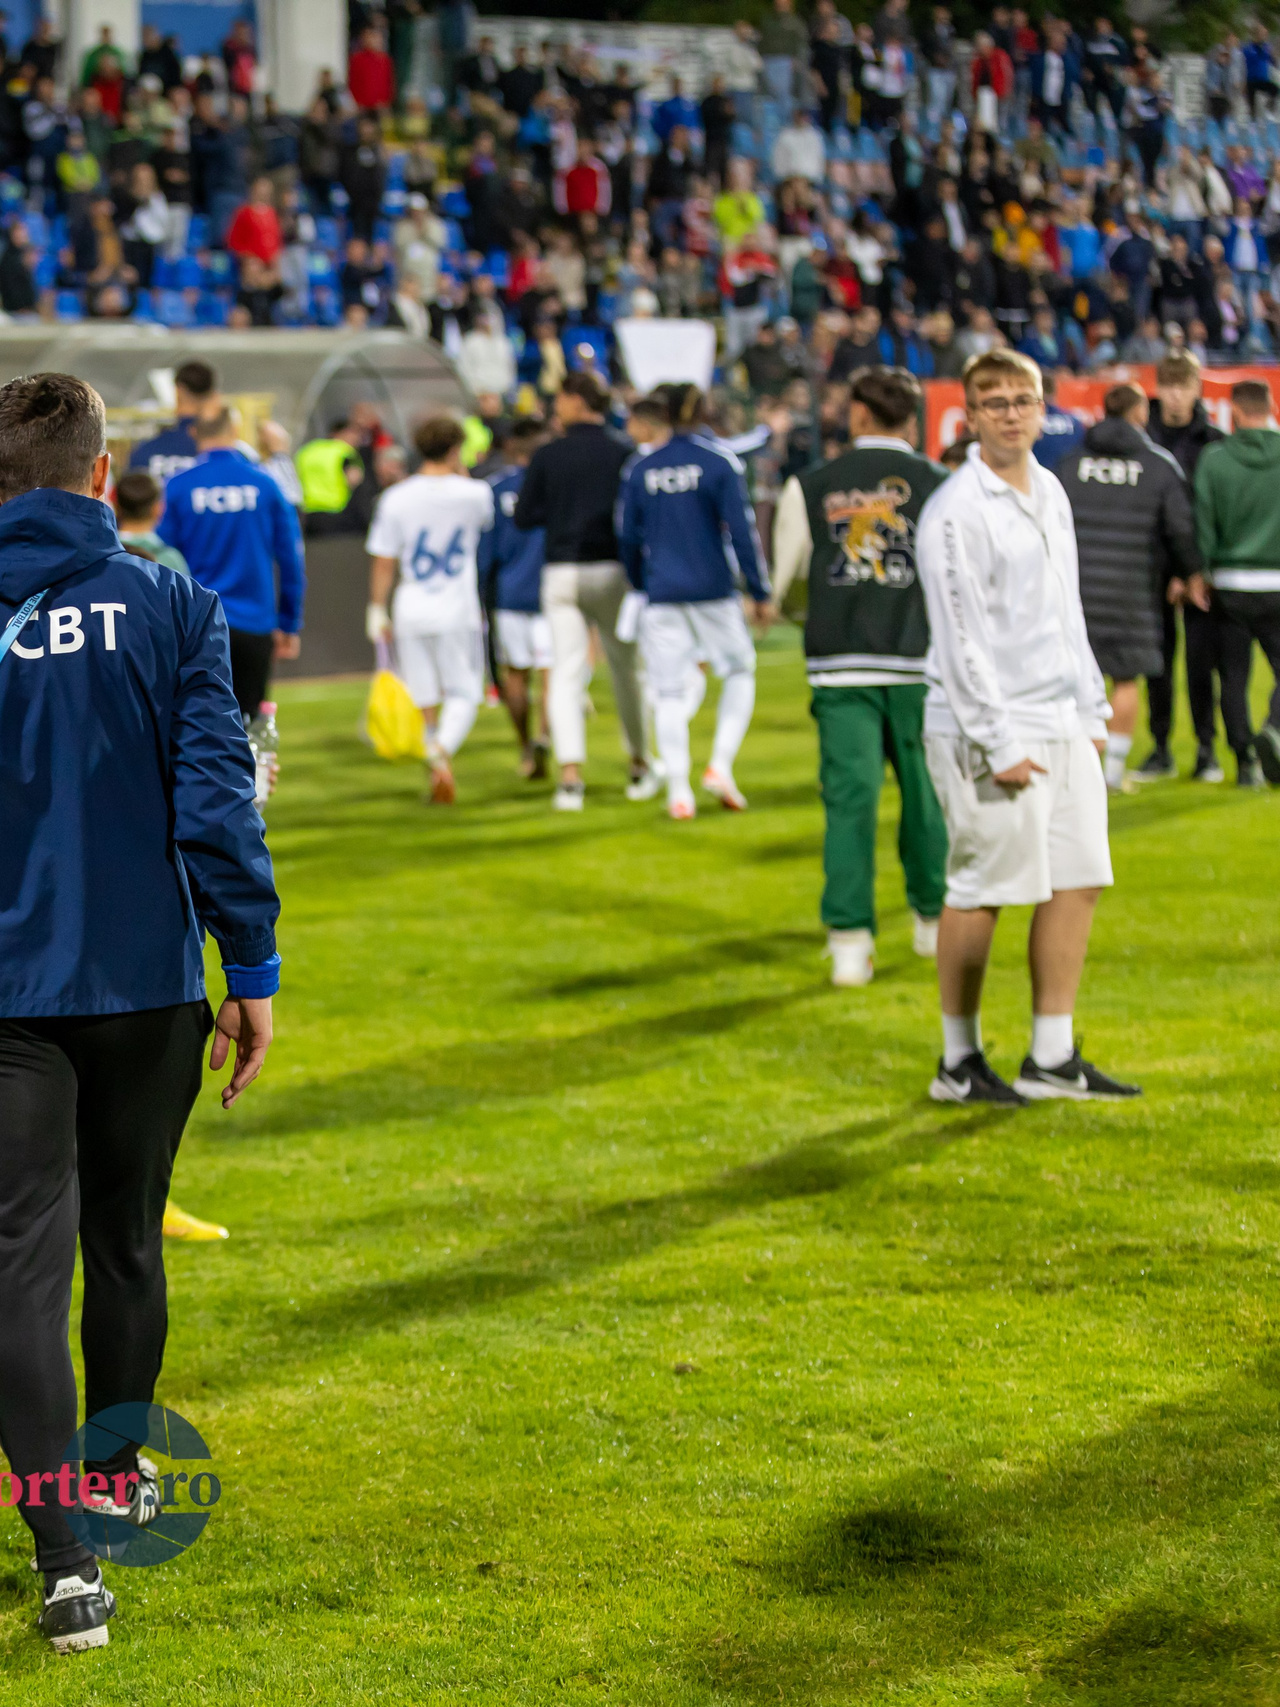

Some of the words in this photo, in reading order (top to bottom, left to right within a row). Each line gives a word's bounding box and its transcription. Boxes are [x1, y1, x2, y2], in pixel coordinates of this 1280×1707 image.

[644, 464, 703, 496] FCBT
[1077, 456, 1143, 487] FCBT
[191, 484, 260, 515] FCBT
[410, 526, 466, 581] 66
[11, 602, 34, 629] FOTBAL
[55, 1584, 85, 1598] adidas
